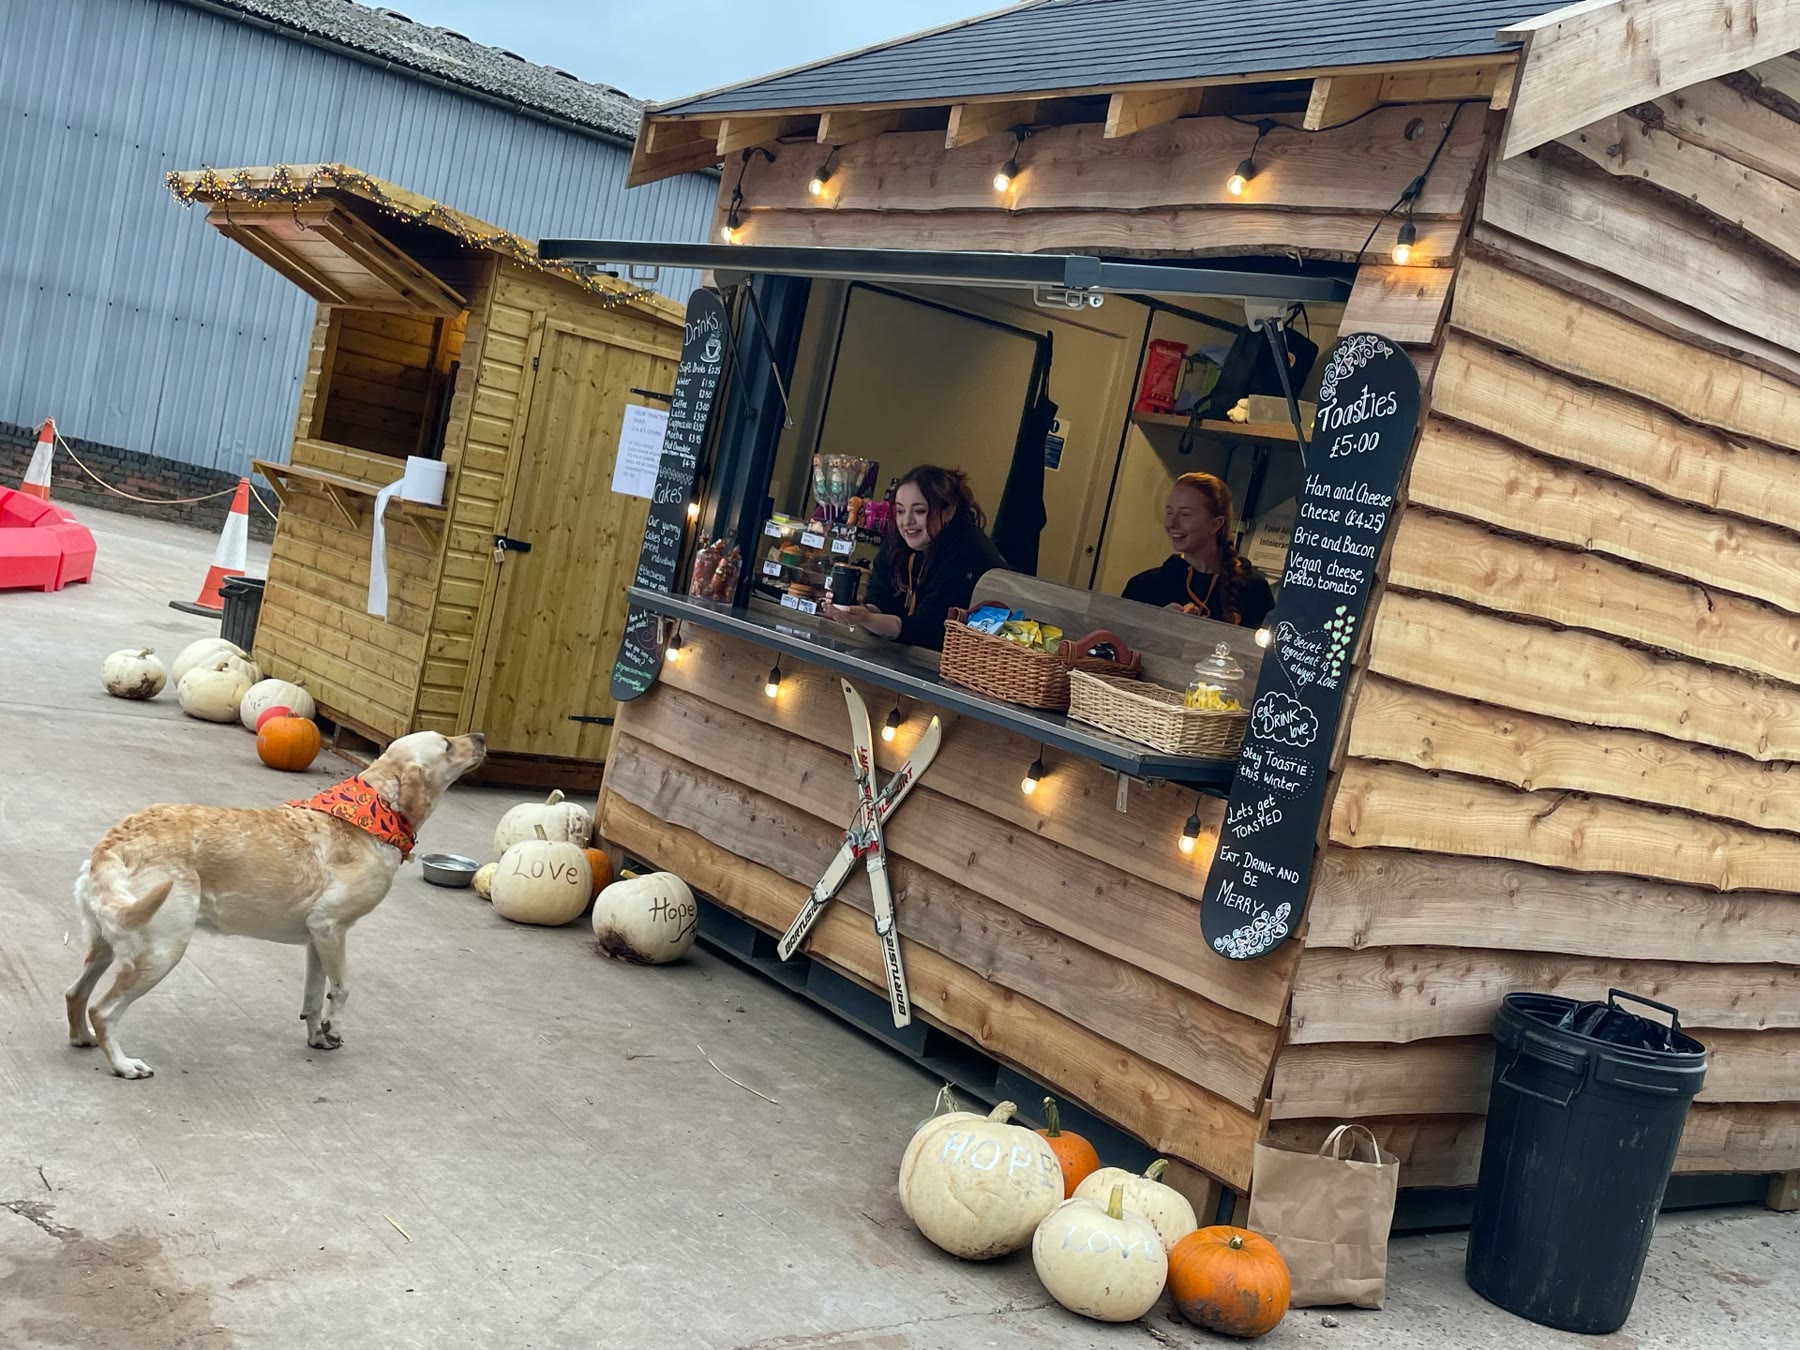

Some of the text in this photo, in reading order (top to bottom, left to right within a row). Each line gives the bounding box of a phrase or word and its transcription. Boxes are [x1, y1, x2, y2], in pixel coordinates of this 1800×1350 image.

[684, 310, 718, 346] Drinks
[675, 388, 685, 397] Tea
[671, 409, 686, 418] Latte
[672, 399, 687, 409] Coffee
[1318, 384, 1397, 432] Toasties
[667, 430, 683, 440] Mocha
[1329, 432, 1380, 458] £5.00
[653, 482, 683, 504] Cakes
[1305, 473, 1392, 507] Ham and Cheese
[1300, 502, 1340, 522] Cheese
[648, 515, 681, 540] Our yummy
[1264, 524, 1280, 533] Food
[641, 541, 659, 555] priced
[663, 537, 674, 547] are
[1294, 526, 1375, 559] Brie and Bacon
[1290, 550, 1364, 583] Vegan cheese,
[1318, 575, 1357, 596] tomato
[1281, 644, 1321, 667] ingredient
[1294, 637, 1322, 654] secret
[1290, 662, 1316, 685] always
[1257, 698, 1275, 718] eat
[1243, 747, 1262, 769] Stay
[1240, 764, 1259, 781] this
[1227, 794, 1276, 824] Lets get
[1231, 809, 1283, 839] TOASTED
[1242, 851, 1276, 876] DRINK
[1277, 868, 1299, 884] AND
[1242, 871, 1259, 888] BE
[1216, 879, 1265, 917] MERRY
[648, 896, 695, 933] Hope
[886, 929, 907, 1016] BARTUSIE
